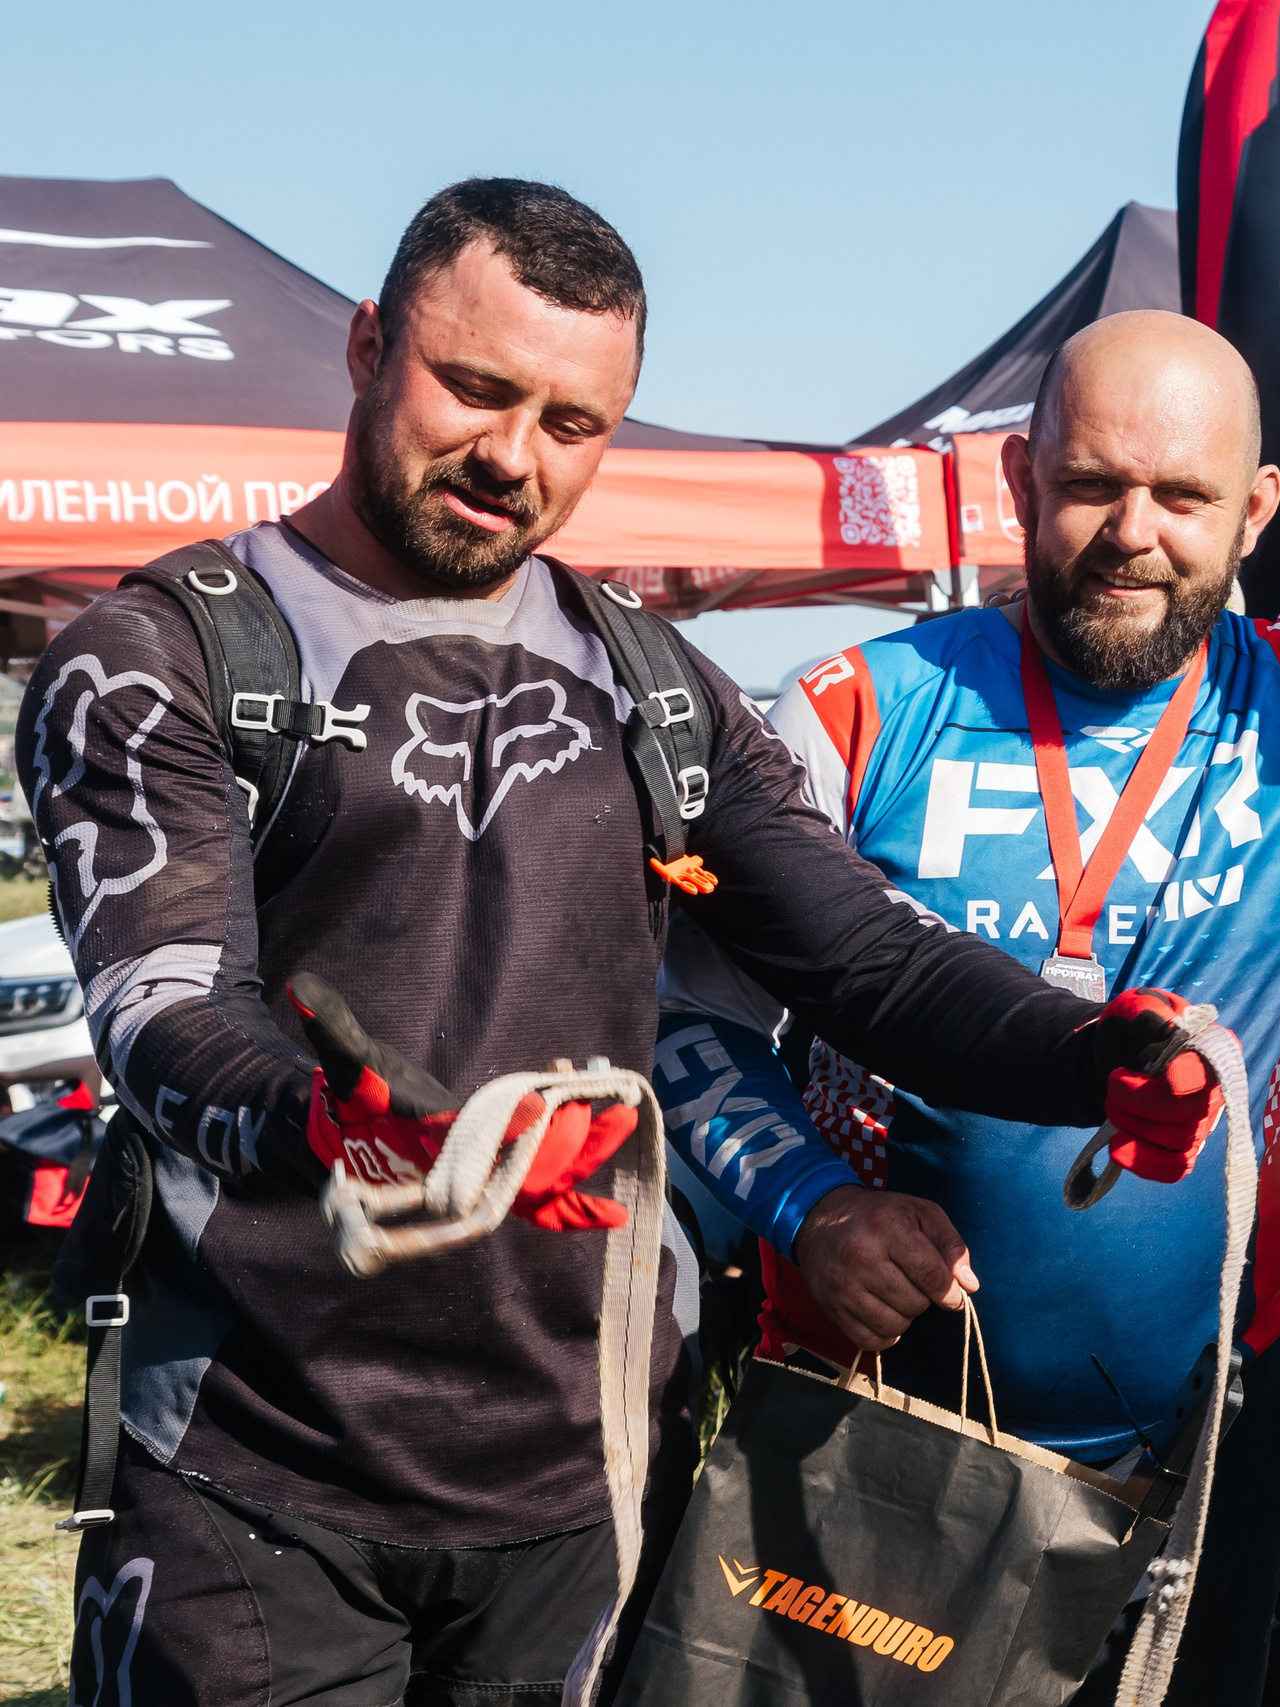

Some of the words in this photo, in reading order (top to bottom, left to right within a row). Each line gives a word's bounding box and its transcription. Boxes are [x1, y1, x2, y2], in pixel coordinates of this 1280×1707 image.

[917, 729, 1263, 884] FXR
[1045, 966, 1100, 982] ПРОХВАТ
[154, 1083, 267, 1174] FOX
[653, 1022, 806, 1202] FXR
[747, 1568, 956, 1665] TAGENDURO
